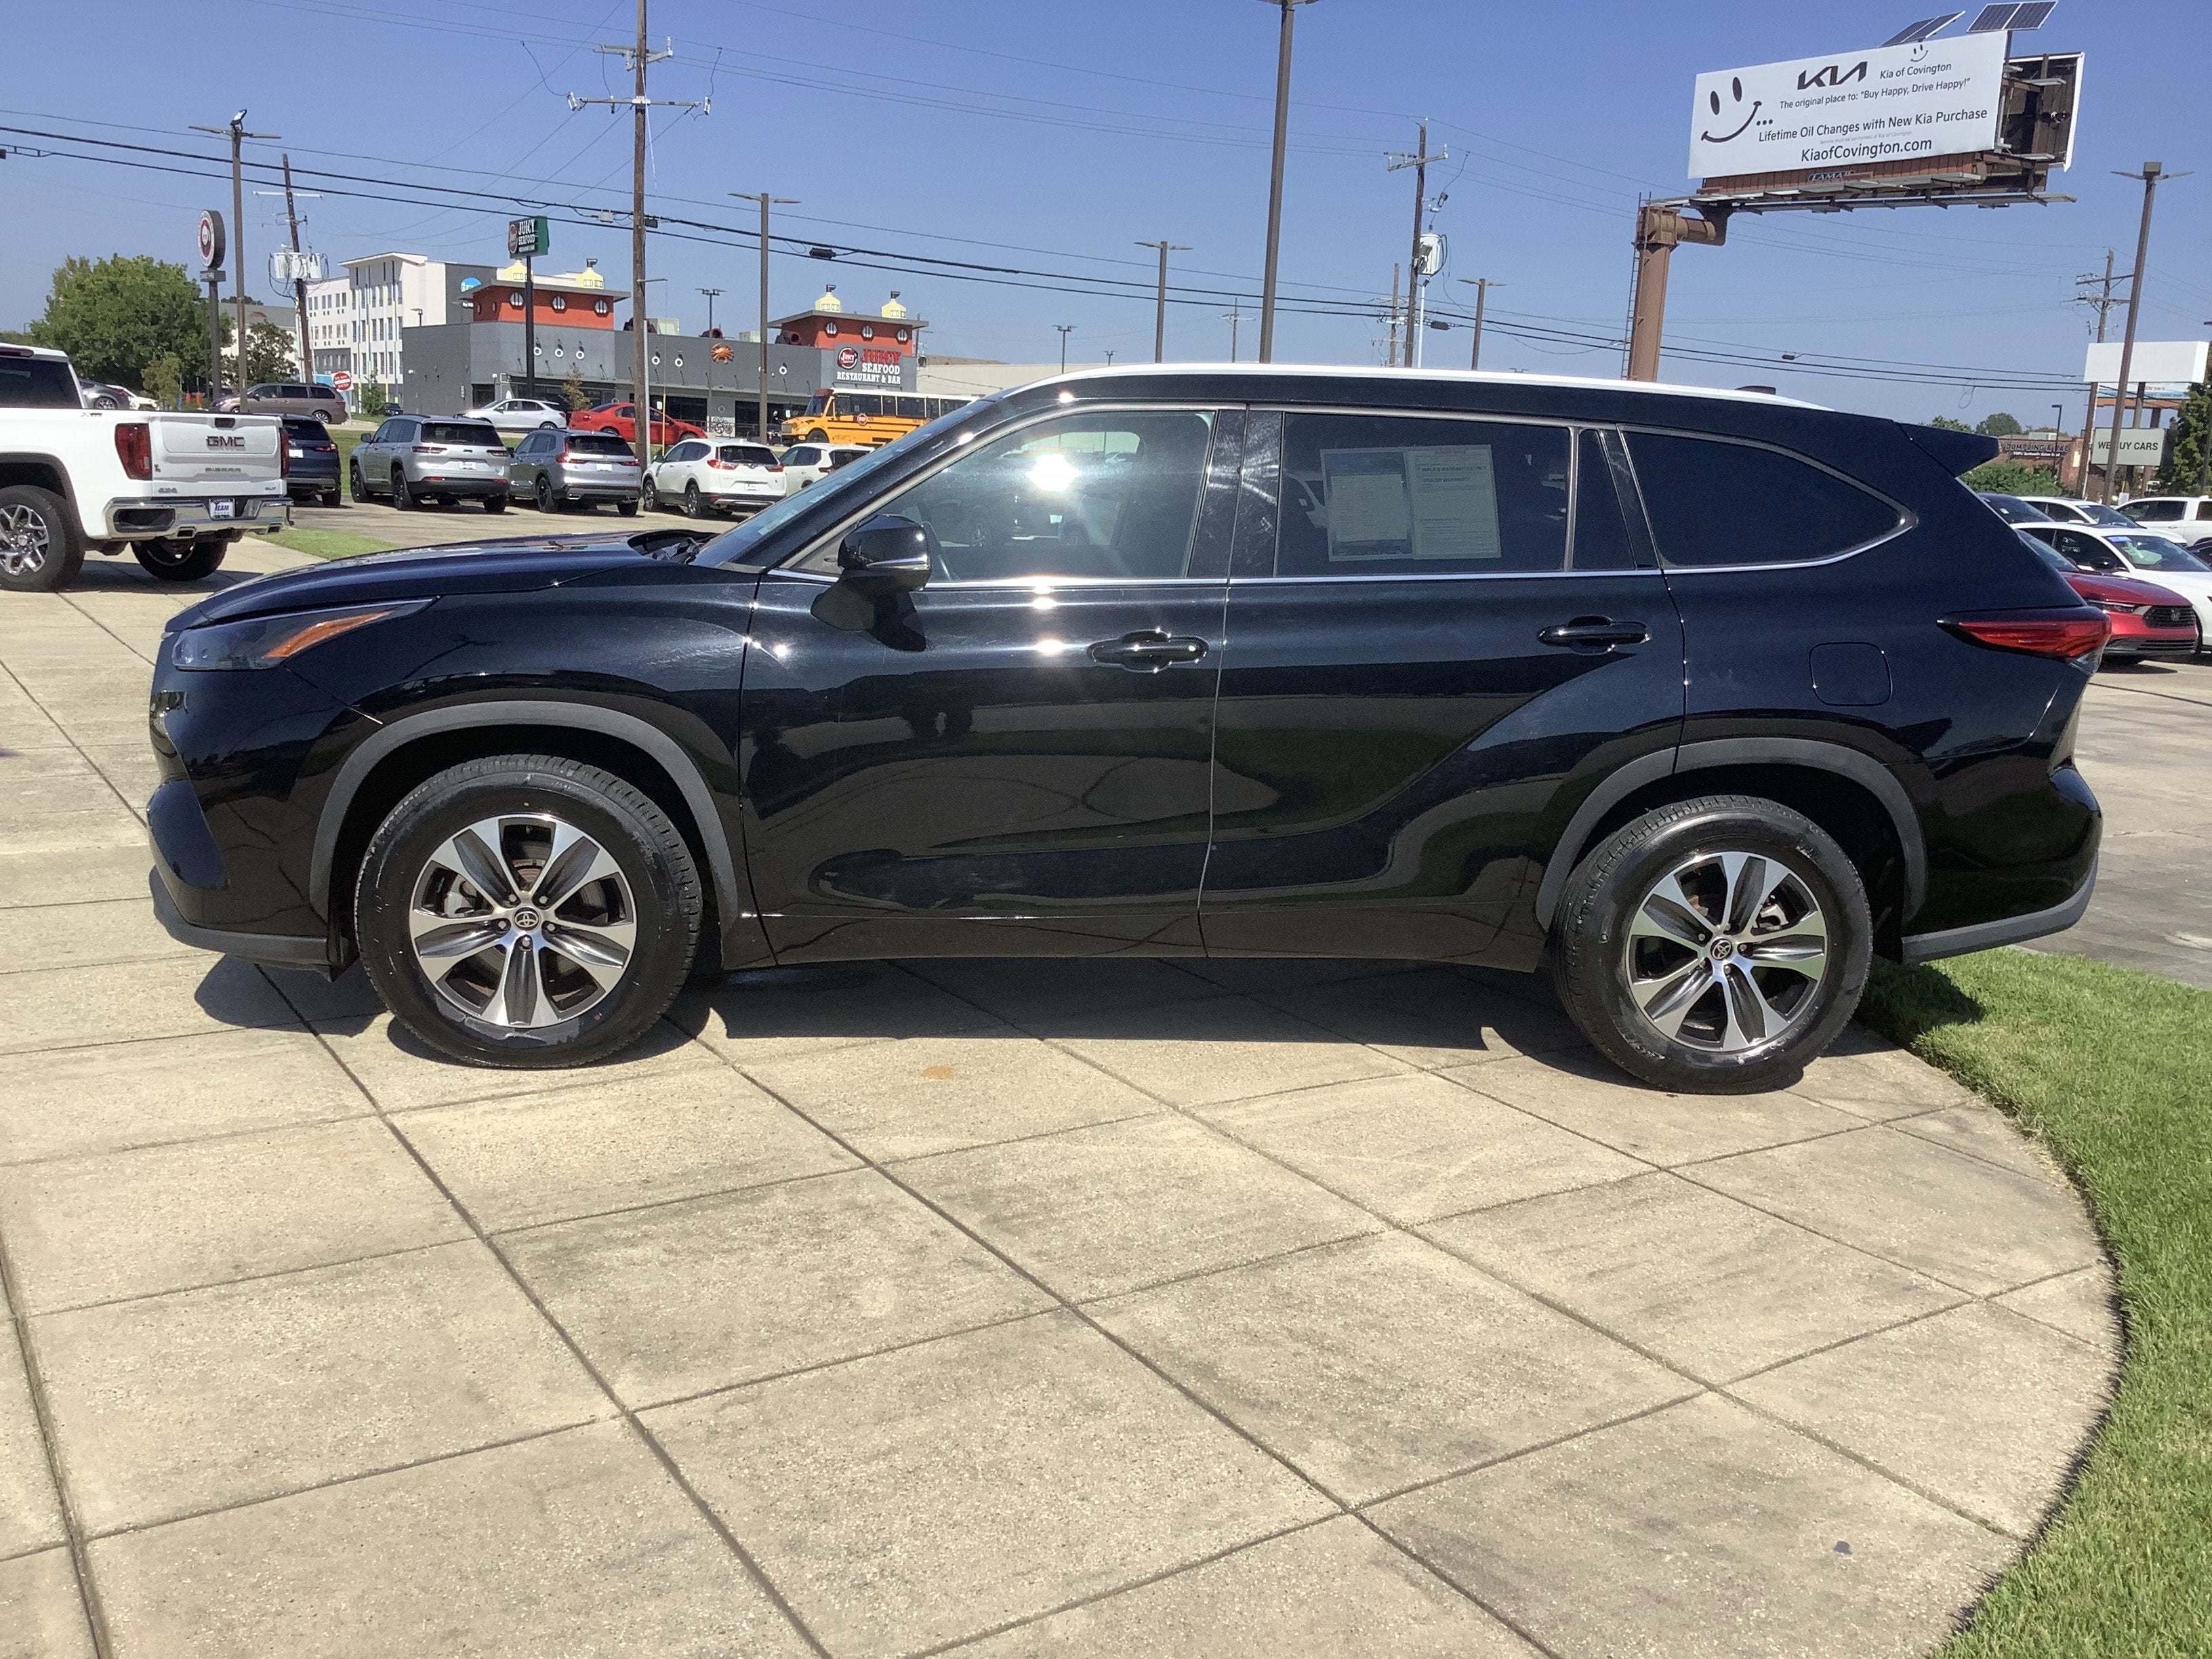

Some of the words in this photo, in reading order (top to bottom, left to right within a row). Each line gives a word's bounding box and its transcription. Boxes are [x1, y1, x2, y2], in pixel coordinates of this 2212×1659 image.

[1880, 70, 1893, 79] Kia
[1896, 68, 1905, 77] of
[1907, 63, 1952, 75] Covington
[1780, 101, 1793, 109] The
[1795, 96, 1824, 108] original
[1825, 95, 1845, 106] place
[1848, 93, 1858, 101] to:
[1860, 90, 1879, 100] "Buy
[1881, 86, 1910, 97] Happy,
[1912, 83, 1933, 93] Drive
[1936, 77, 1971, 90] Happy!"
[1759, 129, 1797, 142] Lifetime
[1800, 126, 1814, 138] Oil
[1816, 122, 1860, 136] Changes
[1862, 118, 1885, 131] with
[1888, 117, 1912, 128] New
[1915, 113, 1932, 125] Kia
[1936, 108, 1988, 123] Purchase
[1801, 138, 1931, 162] KiaofCovington.com
[518, 219, 535, 235] JUICY
[860, 348, 901, 365] JUICY
[861, 363, 901, 375] SEAFOOD
[836, 371, 880, 383] RESTAURANT
[881, 375, 886, 384] &
[887, 375, 901, 384] BAR
[206, 436, 245, 447] GMC
[2005, 443, 2045, 452] DUMPLING
[2133, 442, 2158, 451] CARS
[214, 502, 229, 510] TEAM
